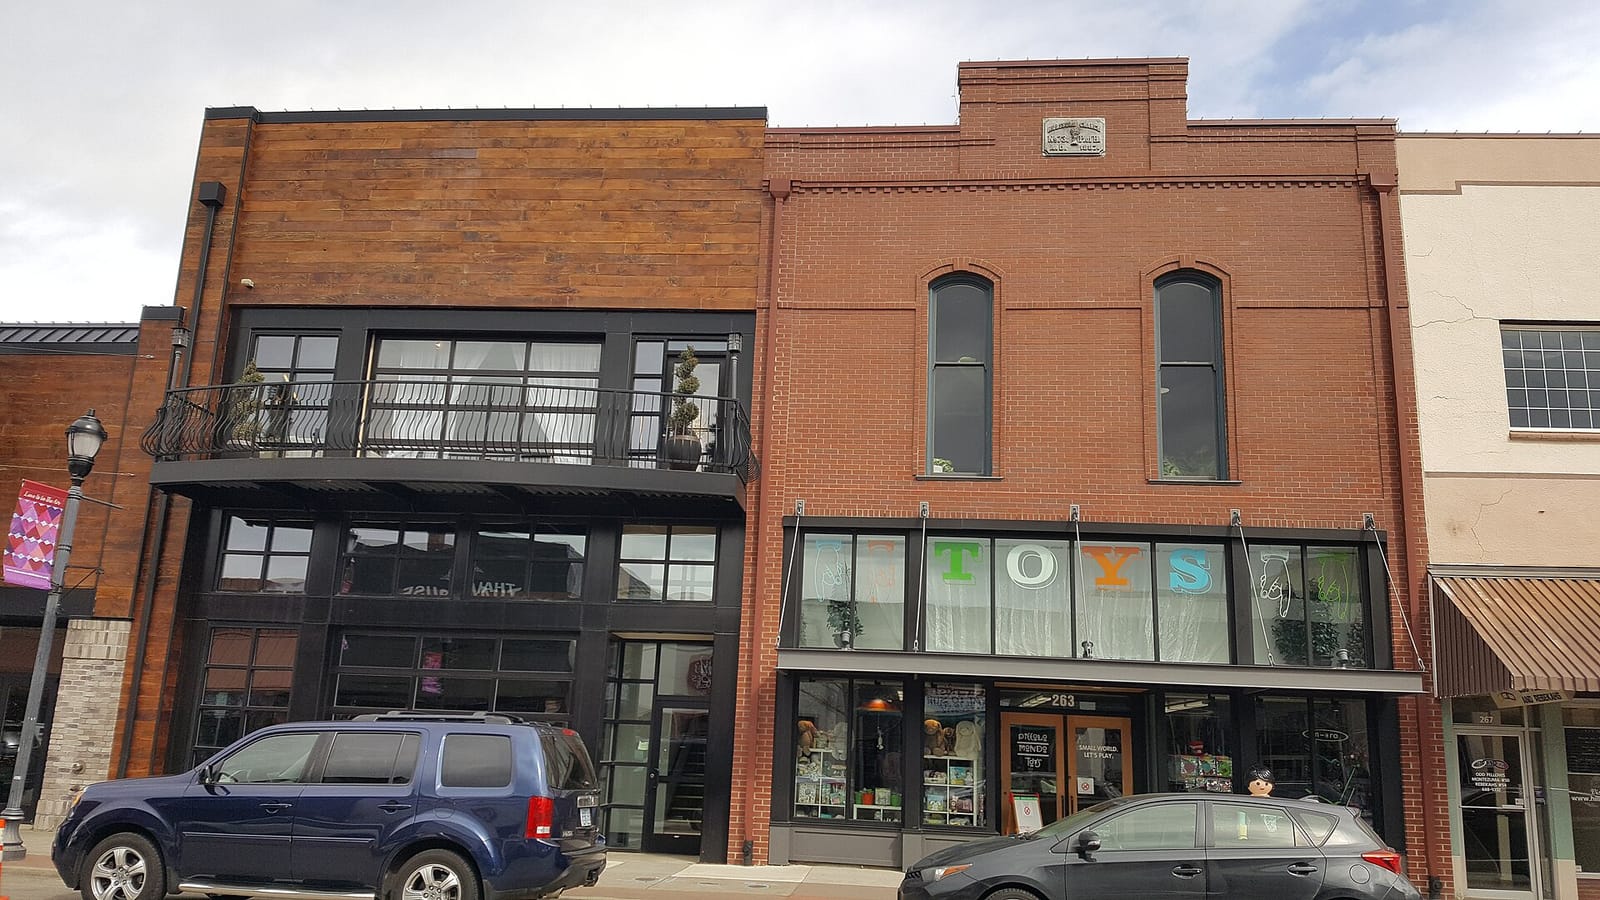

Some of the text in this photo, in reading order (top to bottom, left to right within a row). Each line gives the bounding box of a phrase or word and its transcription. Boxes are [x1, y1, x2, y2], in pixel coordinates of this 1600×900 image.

[934, 541, 1213, 594] TOYS
[1052, 694, 1075, 707] 263
[1479, 715, 1494, 724] 267
[1018, 732, 1048, 742] PICCOLO
